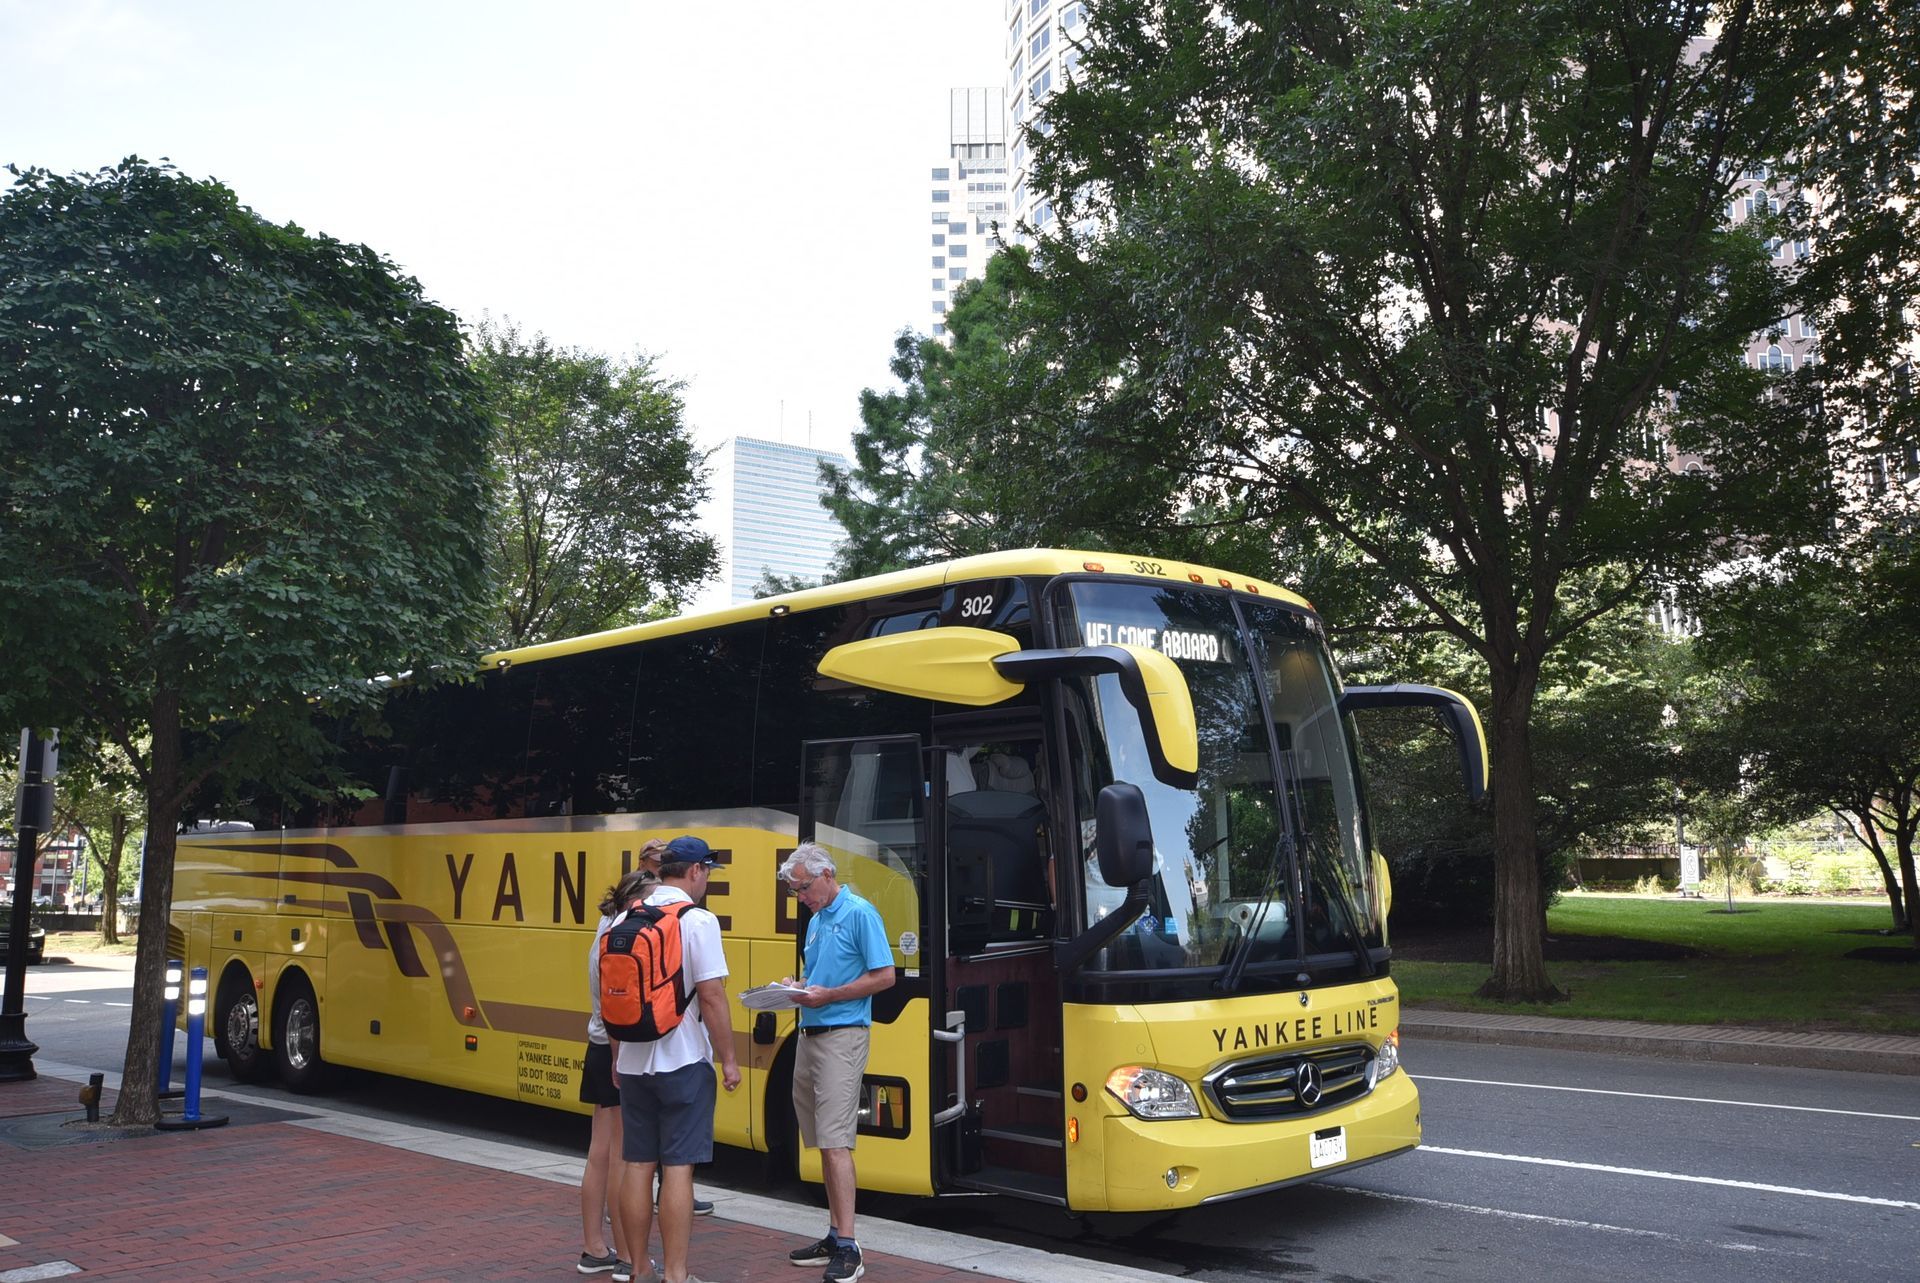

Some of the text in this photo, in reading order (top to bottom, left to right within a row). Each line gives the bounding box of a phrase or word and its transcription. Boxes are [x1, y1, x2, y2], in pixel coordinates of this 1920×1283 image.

[1130, 560, 1167, 577] 302
[961, 594, 993, 618] 302
[1086, 622, 1218, 661] WELCOME ABOARD
[1212, 1007, 1377, 1052] YANKEE LINE
[519, 1041, 540, 1050] OPERATED
[519, 1051, 524, 1060] A
[525, 1052, 552, 1066] YANKEE
[553, 1056, 571, 1071] LINE,
[519, 1067, 568, 1085] US DOT 189328
[519, 1083, 561, 1099] WMATC 1638
